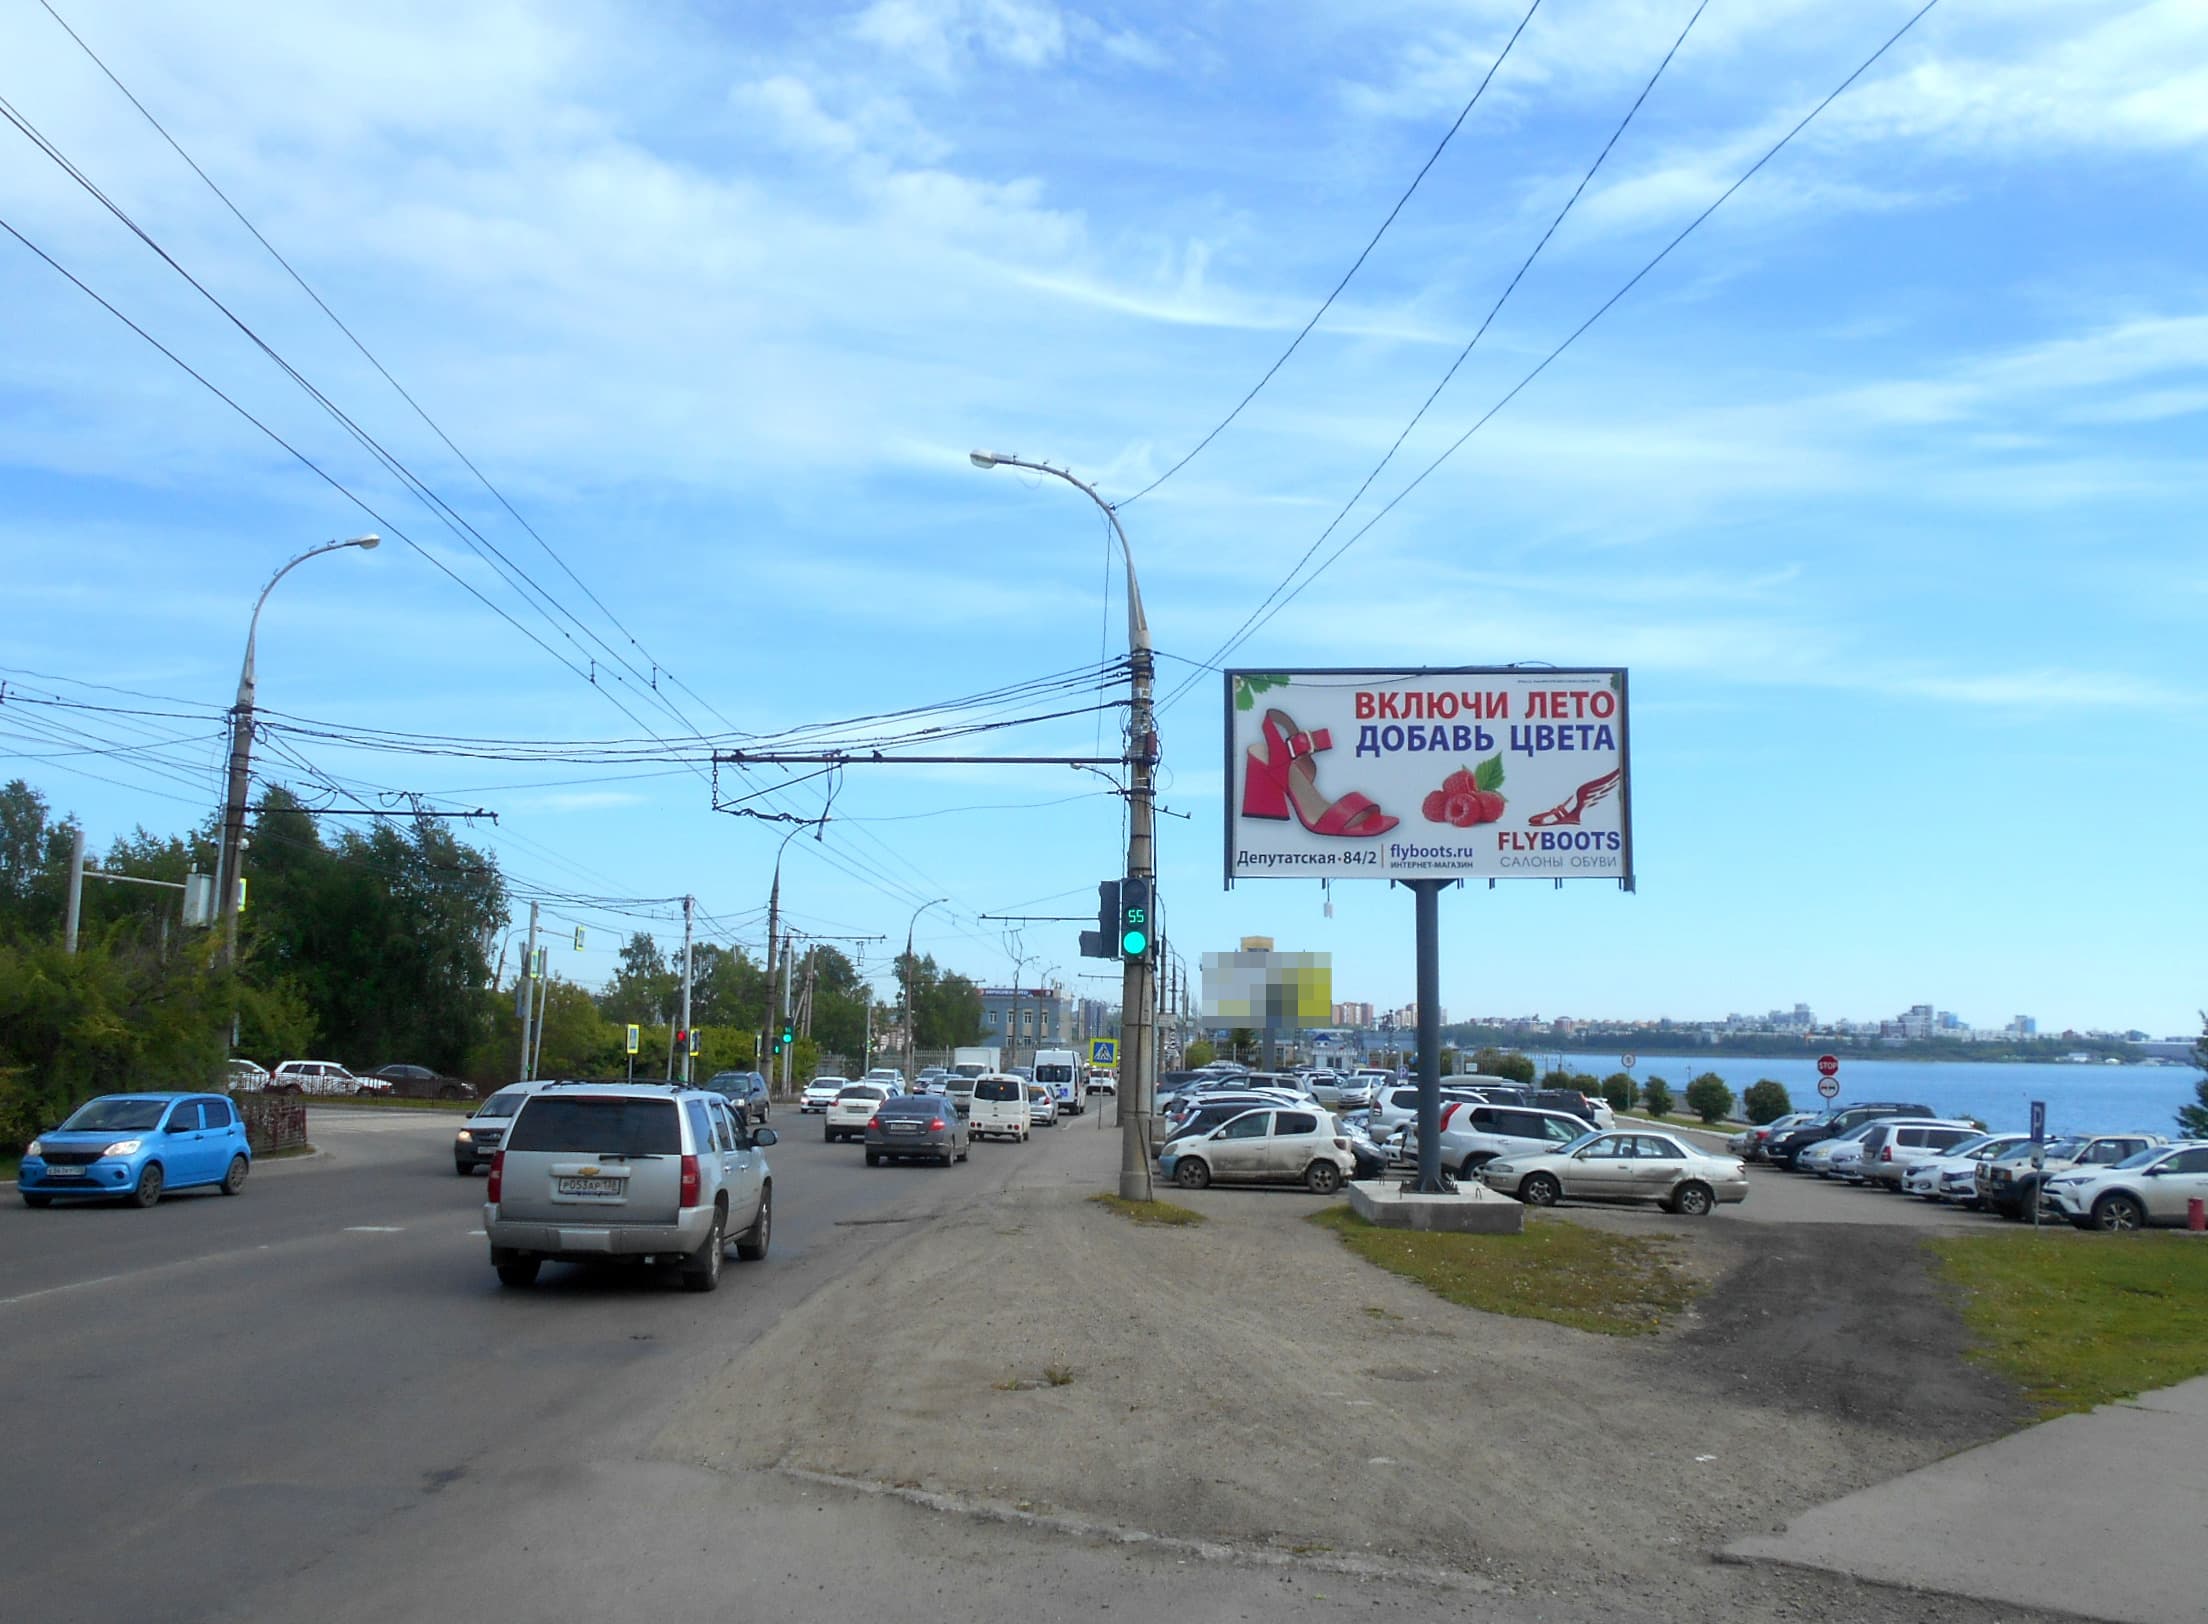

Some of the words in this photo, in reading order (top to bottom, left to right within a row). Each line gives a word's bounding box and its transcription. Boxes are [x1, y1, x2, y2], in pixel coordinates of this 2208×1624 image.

[1355, 691, 1509, 720] ВКЛЮЧИ
[1524, 690, 1616, 719] ЛЕТО
[1355, 724, 1496, 758] ДОБАВЬ
[1510, 724, 1617, 758] ЦВЕТА
[1497, 831, 1621, 851] FLYBOOTS
[1390, 843, 1474, 864] flyboots.ru
[1499, 856, 1564, 868] САЛОНЫ
[1570, 856, 1617, 868] ОБУВИ
[1390, 861, 1474, 869] ИНТЕРНЕТ-МАГАЗИН
[1128, 909, 1145, 923] 55
[1819, 1061, 1838, 1070] STOP
